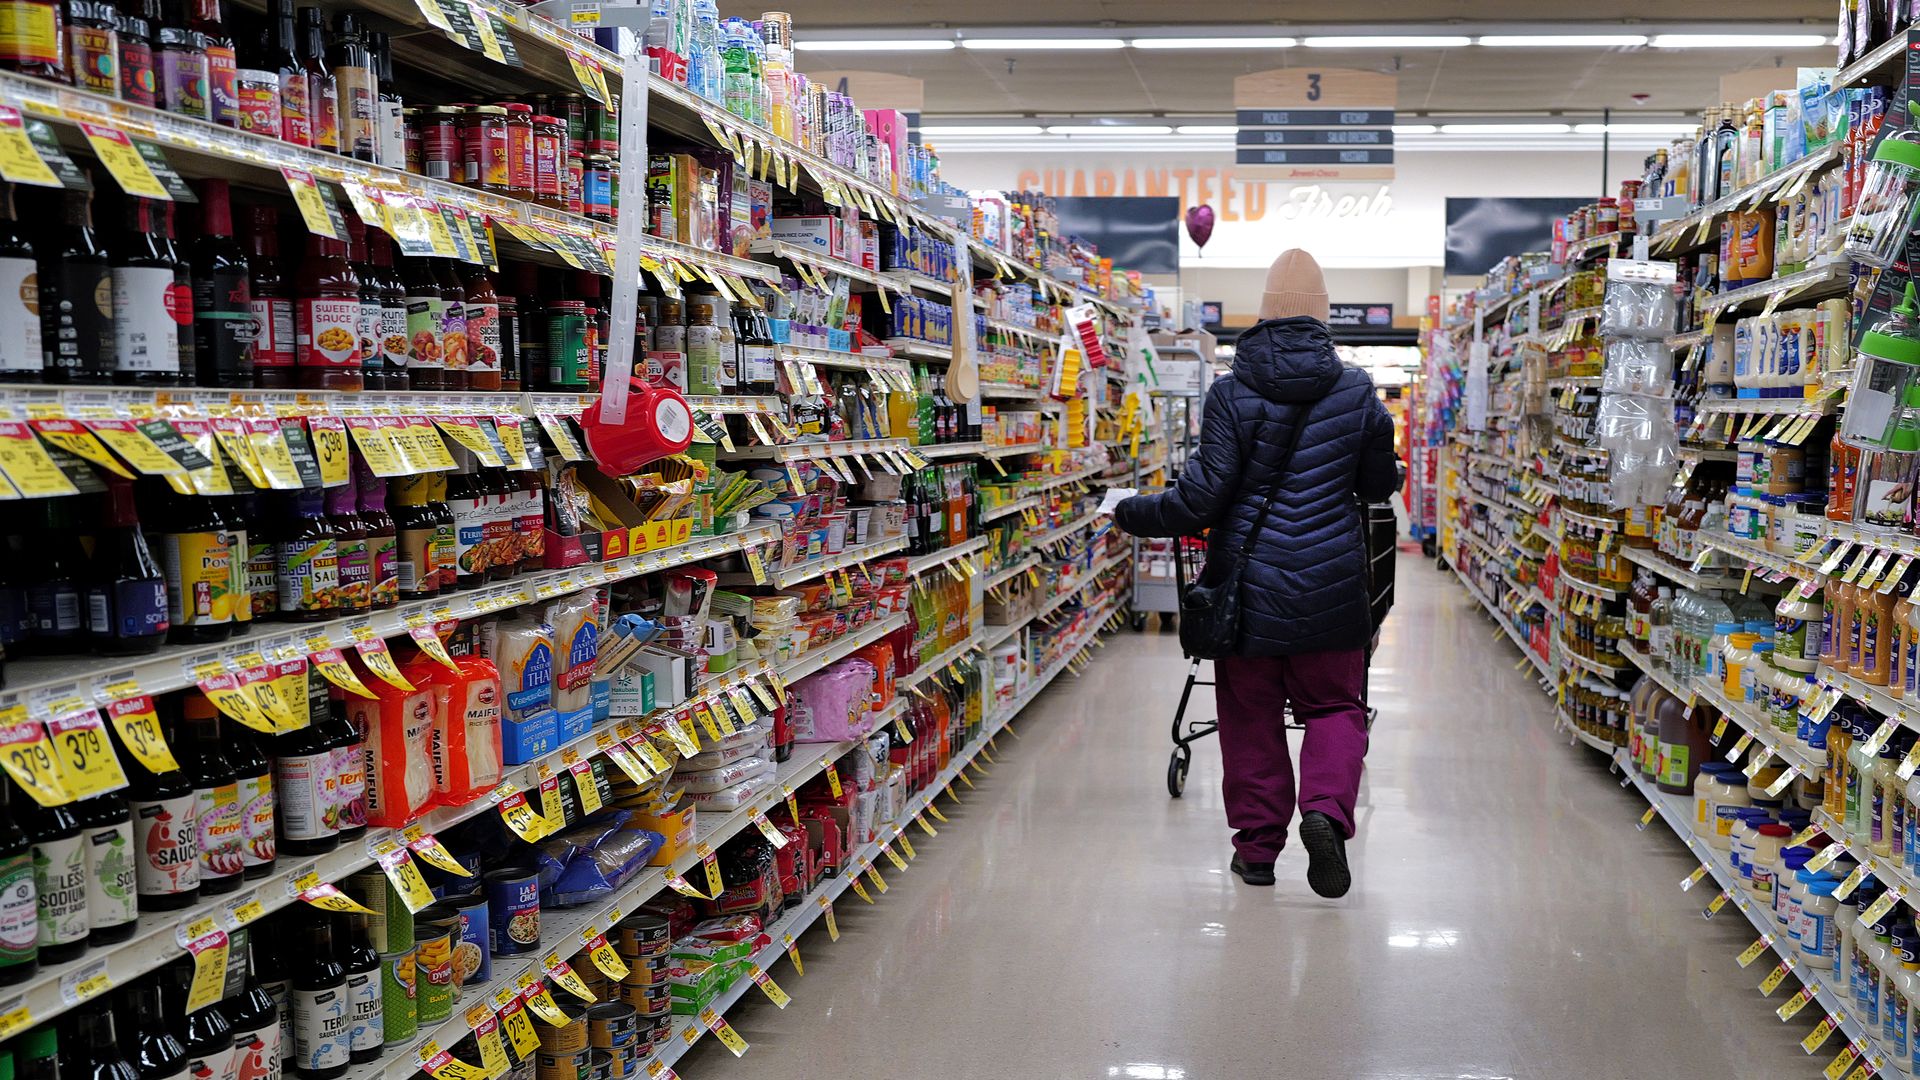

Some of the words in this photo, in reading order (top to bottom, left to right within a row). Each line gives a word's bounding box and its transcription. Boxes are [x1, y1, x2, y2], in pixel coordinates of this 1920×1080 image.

[211, 56, 228, 67] FLY
[1306, 74, 1321, 101] 3
[1262, 112, 1289, 124] PICKLES
[1340, 112, 1369, 124] KETCHUP
[1264, 132, 1284, 143] SALSA
[1327, 132, 1347, 143] SALAD
[1348, 132, 1379, 143] DRESSING
[1340, 151, 1369, 162] MUSTARD
[1278, 184, 1393, 220] Fresh
[315, 304, 350, 313] SWEET
[381, 311, 405, 319] KUNG
[315, 314, 352, 323] SAUCE
[38, 420, 73, 432] Sale!
[178, 421, 210, 434] Sale!
[252, 421, 275, 432] Sale!
[323, 432, 342, 463] 398
[361, 437, 386, 452] FREE
[417, 434, 441, 449] FREE
[340, 567, 361, 576] SWEET
[582, 627, 592, 642] A
[361, 641, 381, 652] Sale!
[450, 640, 471, 656] THAI
[316, 651, 339, 663] Sale!
[536, 648, 546, 664] A
[280, 662, 302, 675] Sale!
[367, 653, 389, 679] 379
[244, 667, 268, 681] Sale!
[323, 663, 347, 689] 379
[204, 676, 231, 691] Sale!
[253, 683, 279, 711] 479
[117, 699, 145, 715] Sale!
[219, 692, 251, 722] 379
[616, 705, 638, 714] 7.1.26
[125, 716, 157, 757] 379
[65, 729, 101, 771] 379
[432, 729, 443, 785] MAIFUN
[10, 745, 51, 787] 379
[365, 750, 378, 810] MAIFUN
[502, 796, 521, 809] Sale!
[509, 808, 531, 832] 579
[158, 846, 198, 866] SAUCE
[60, 870, 85, 890] LESS
[394, 863, 417, 893] 379
[39, 886, 86, 909] SODIUM
[519, 893, 537, 903] CHOY
[520, 886, 530, 896] LA
[50, 906, 68, 918] SOY
[596, 950, 613, 972] 199
[562, 974, 579, 991] 199
[523, 985, 540, 998] Sale!
[502, 1002, 518, 1017] Sale!
[532, 994, 550, 1016] 199
[318, 1030, 336, 1039] SAUCE
[479, 1020, 495, 1036] Sale!
[508, 1013, 528, 1045] 279
[427, 1054, 447, 1070] Sale!
